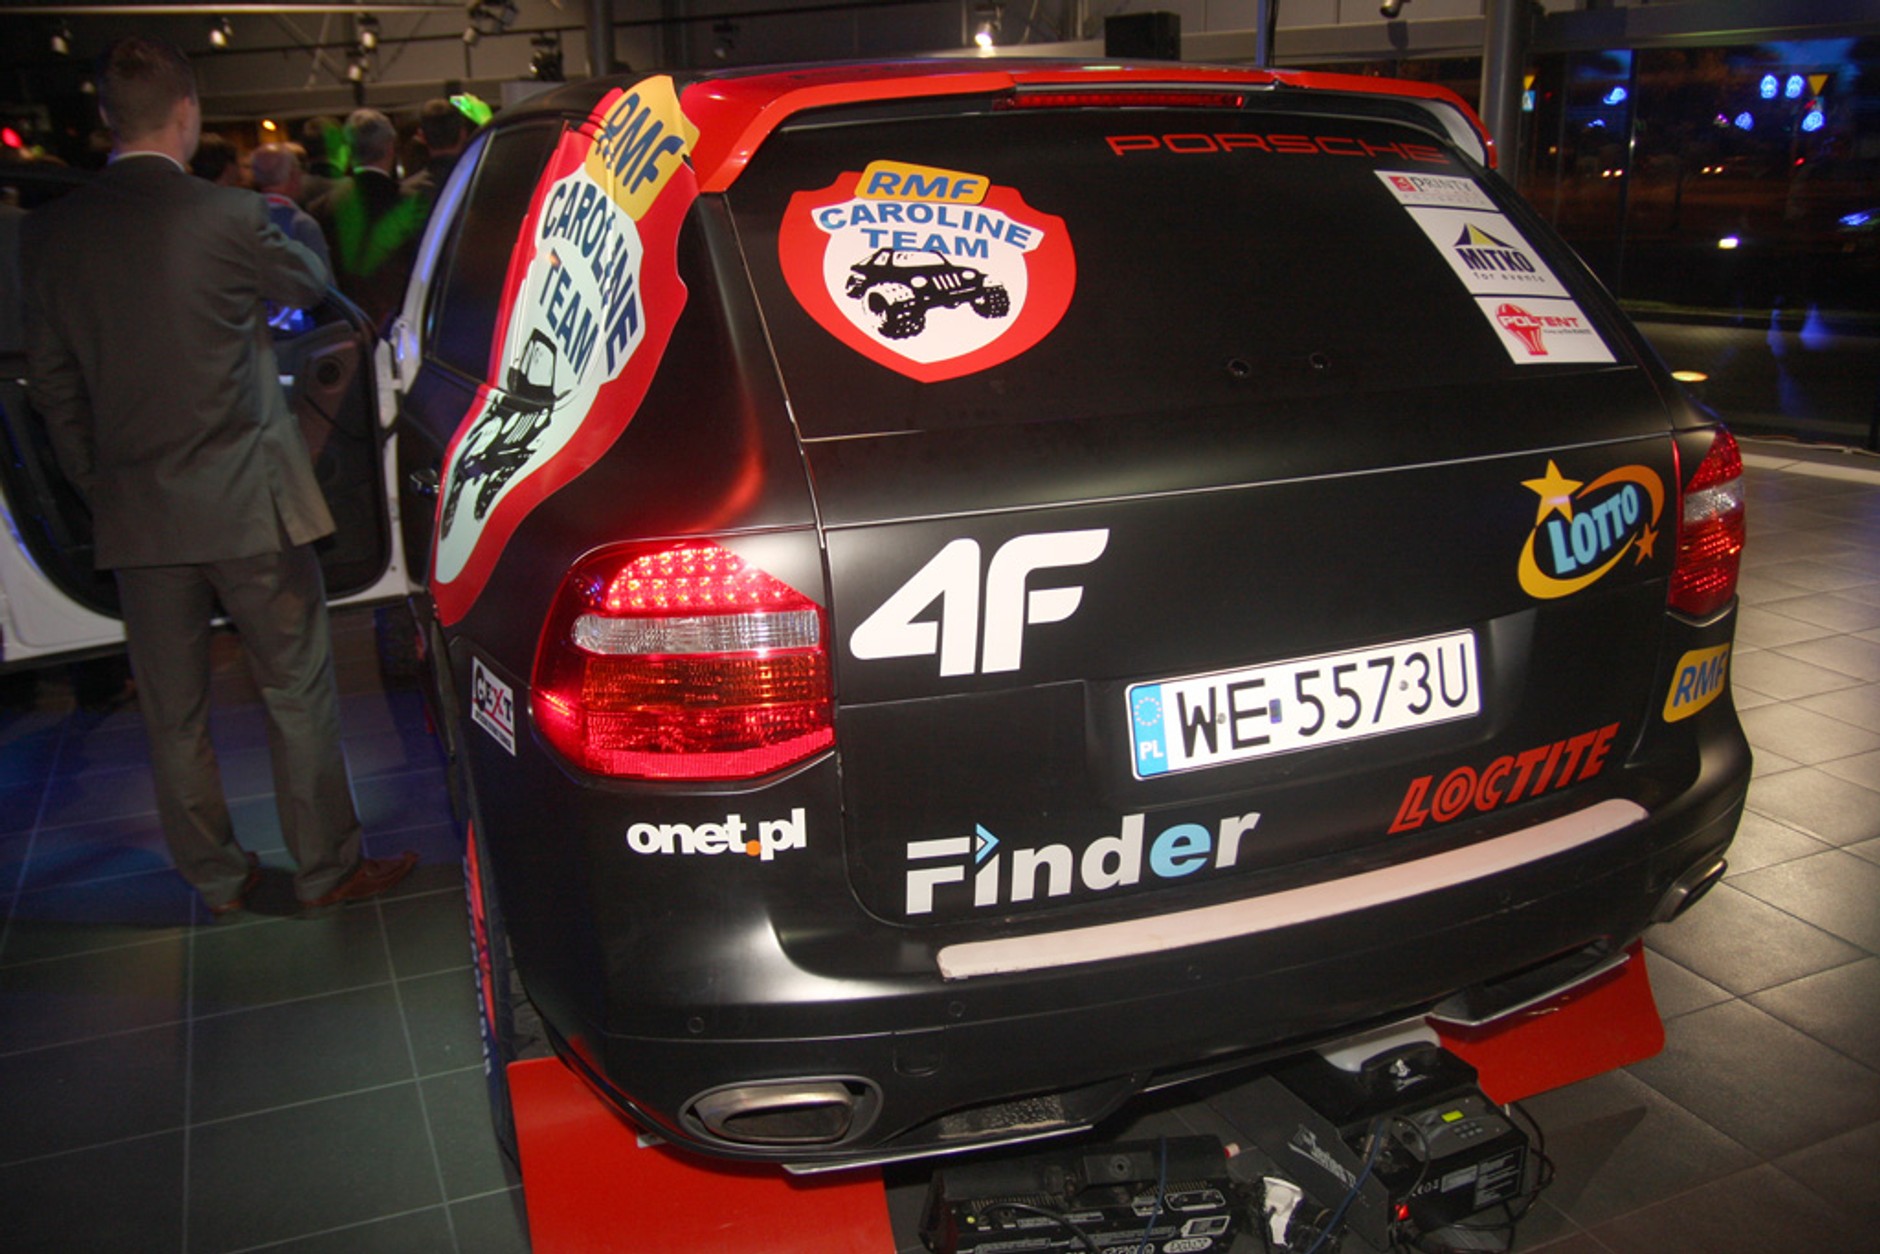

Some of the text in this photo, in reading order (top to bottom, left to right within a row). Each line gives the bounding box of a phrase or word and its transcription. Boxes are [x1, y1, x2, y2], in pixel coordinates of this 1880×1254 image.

[595, 92, 684, 194] RMF
[1105, 132, 1450, 165] PORSCHE
[866, 171, 979, 200] RMF
[819, 202, 1032, 250] CAROLINE
[860, 228, 989, 259] TEAM
[1456, 248, 1536, 273] MITKO
[542, 180, 639, 377] CAROLINE
[539, 249, 600, 384] TEAM
[1548, 484, 1640, 575] LOTTO
[849, 528, 1110, 678] 4F
[1176, 641, 1472, 760] WE 5573U
[1672, 650, 1731, 708] RMF
[1139, 740, 1164, 761] PL
[1386, 722, 1620, 836] LOCTITE
[626, 808, 807, 861] onet.pl
[905, 811, 1261, 915] Finder
